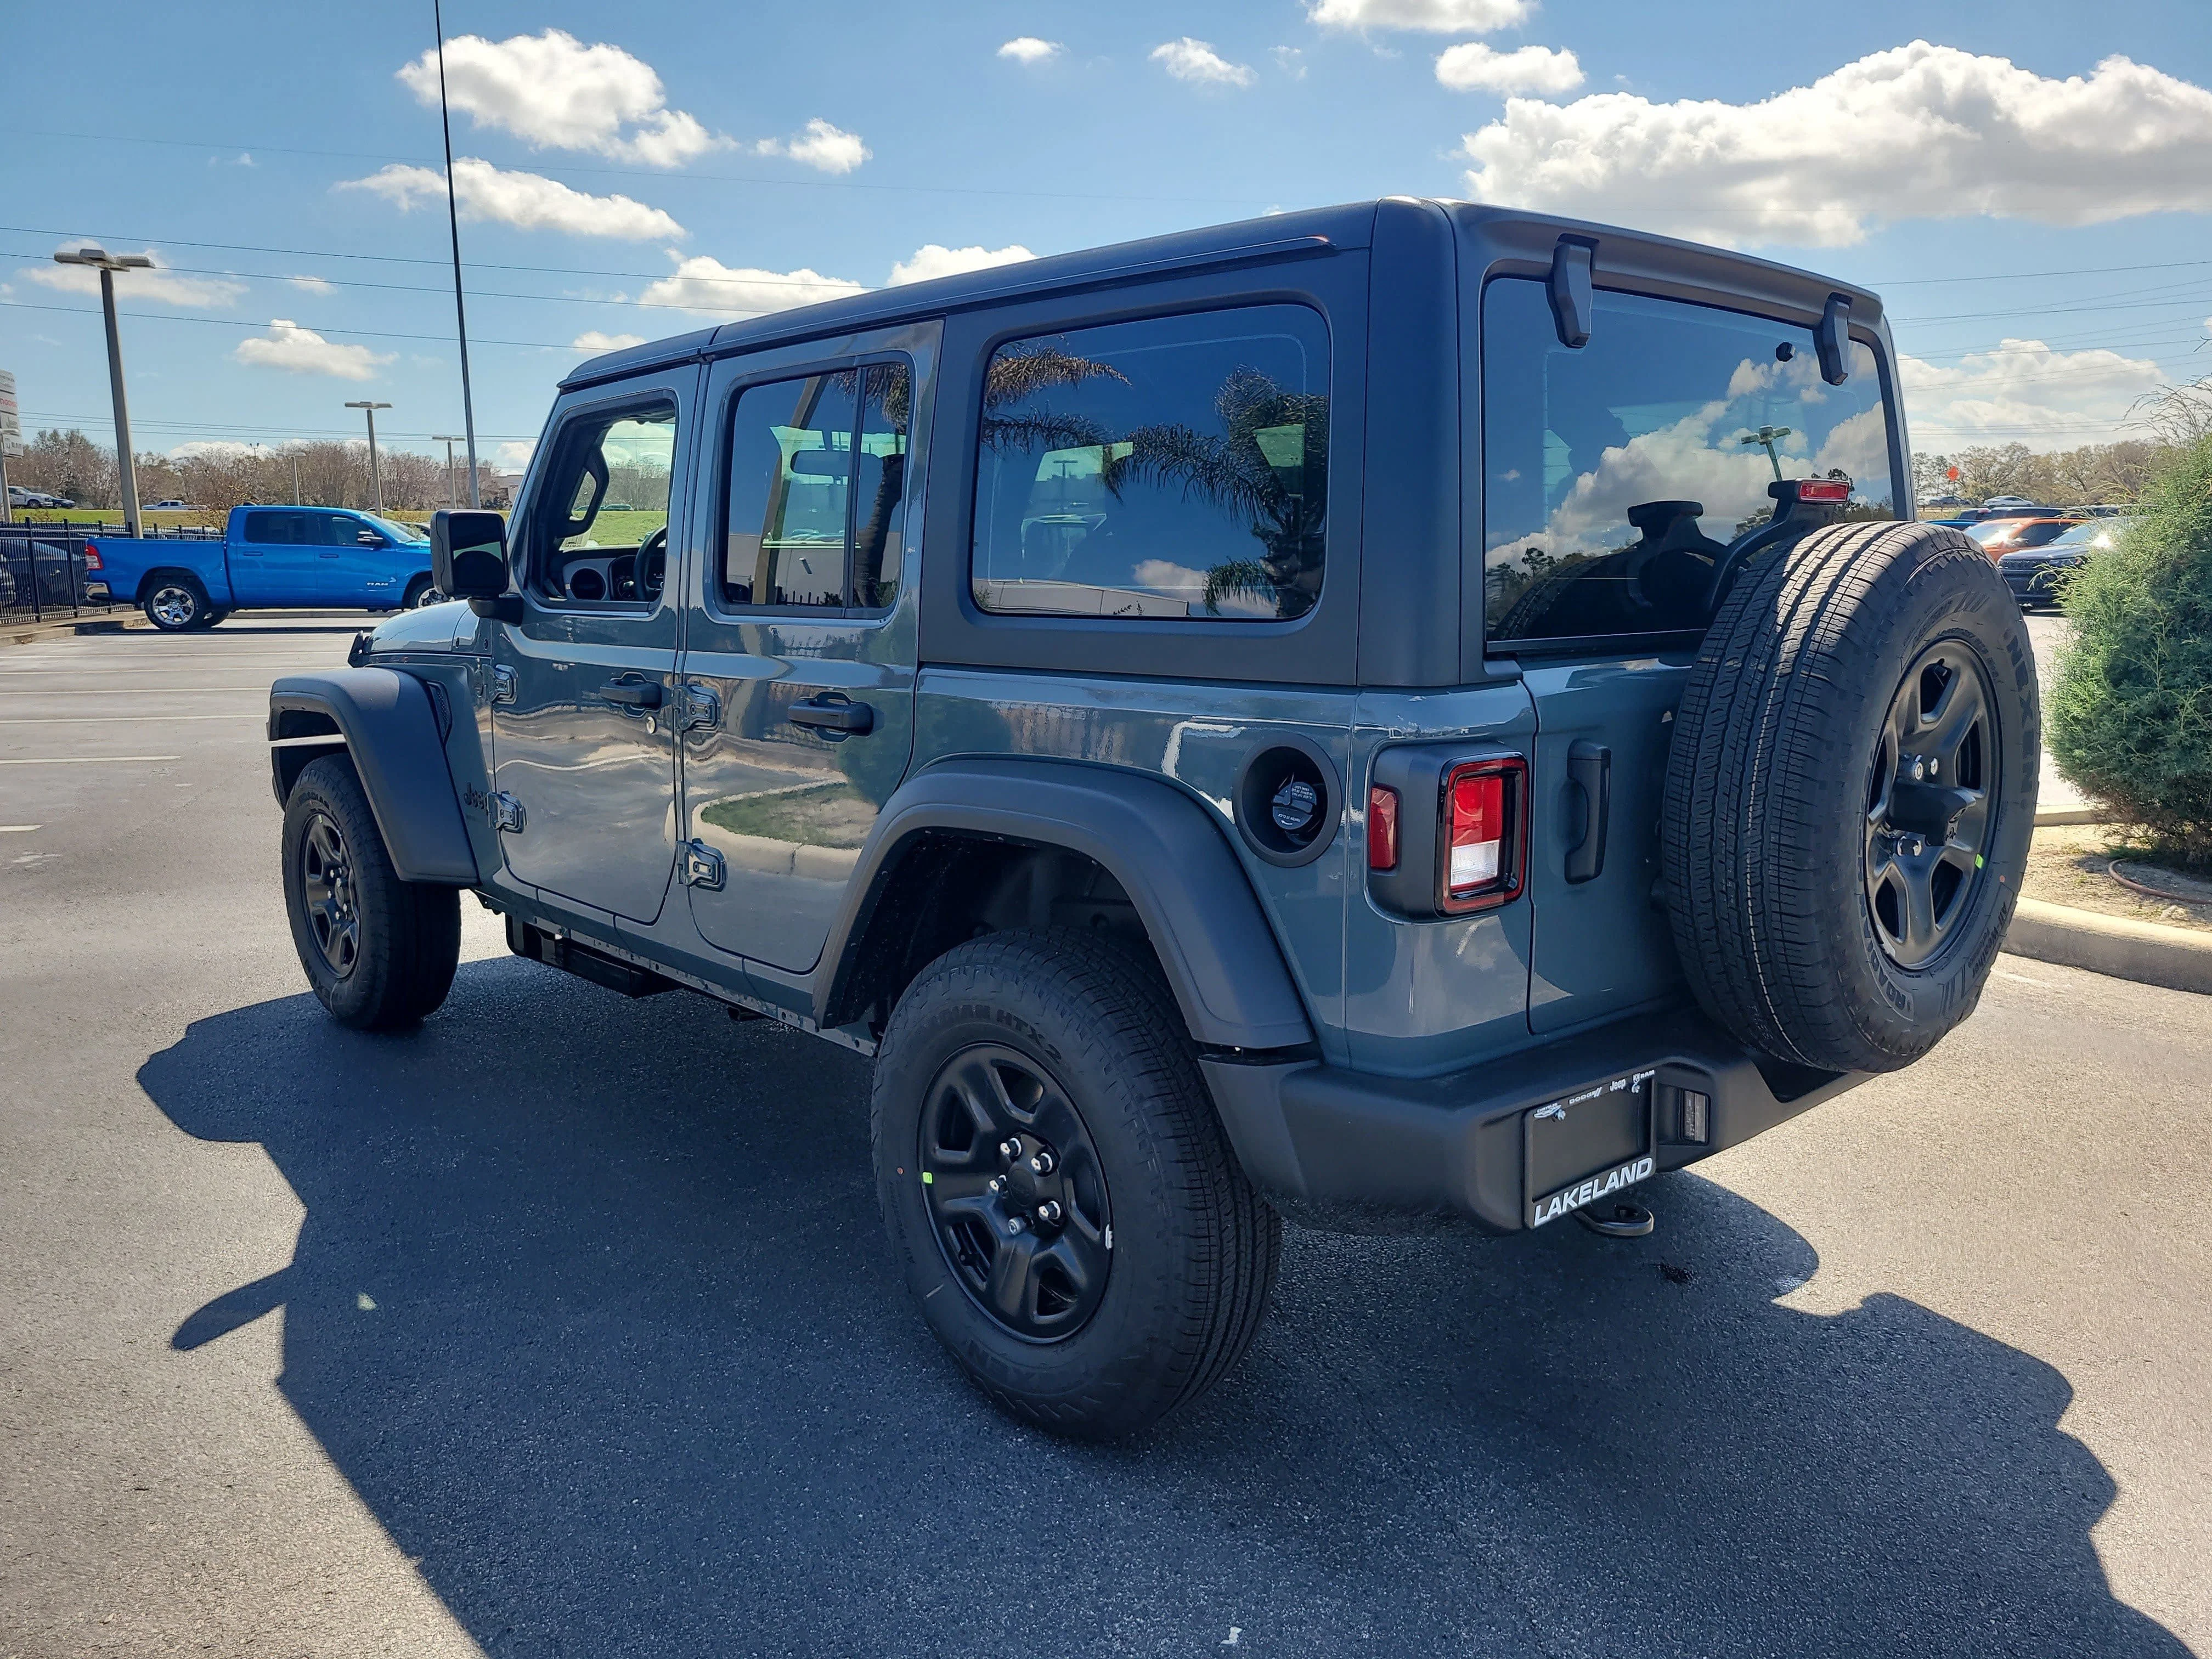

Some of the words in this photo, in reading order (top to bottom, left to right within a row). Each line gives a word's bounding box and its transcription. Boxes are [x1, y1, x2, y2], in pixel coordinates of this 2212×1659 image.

[1609, 1079, 1626, 1092] Jeep
[1640, 1070, 1655, 1079] RAM
[1533, 1157, 1652, 1226] LAKELAND
